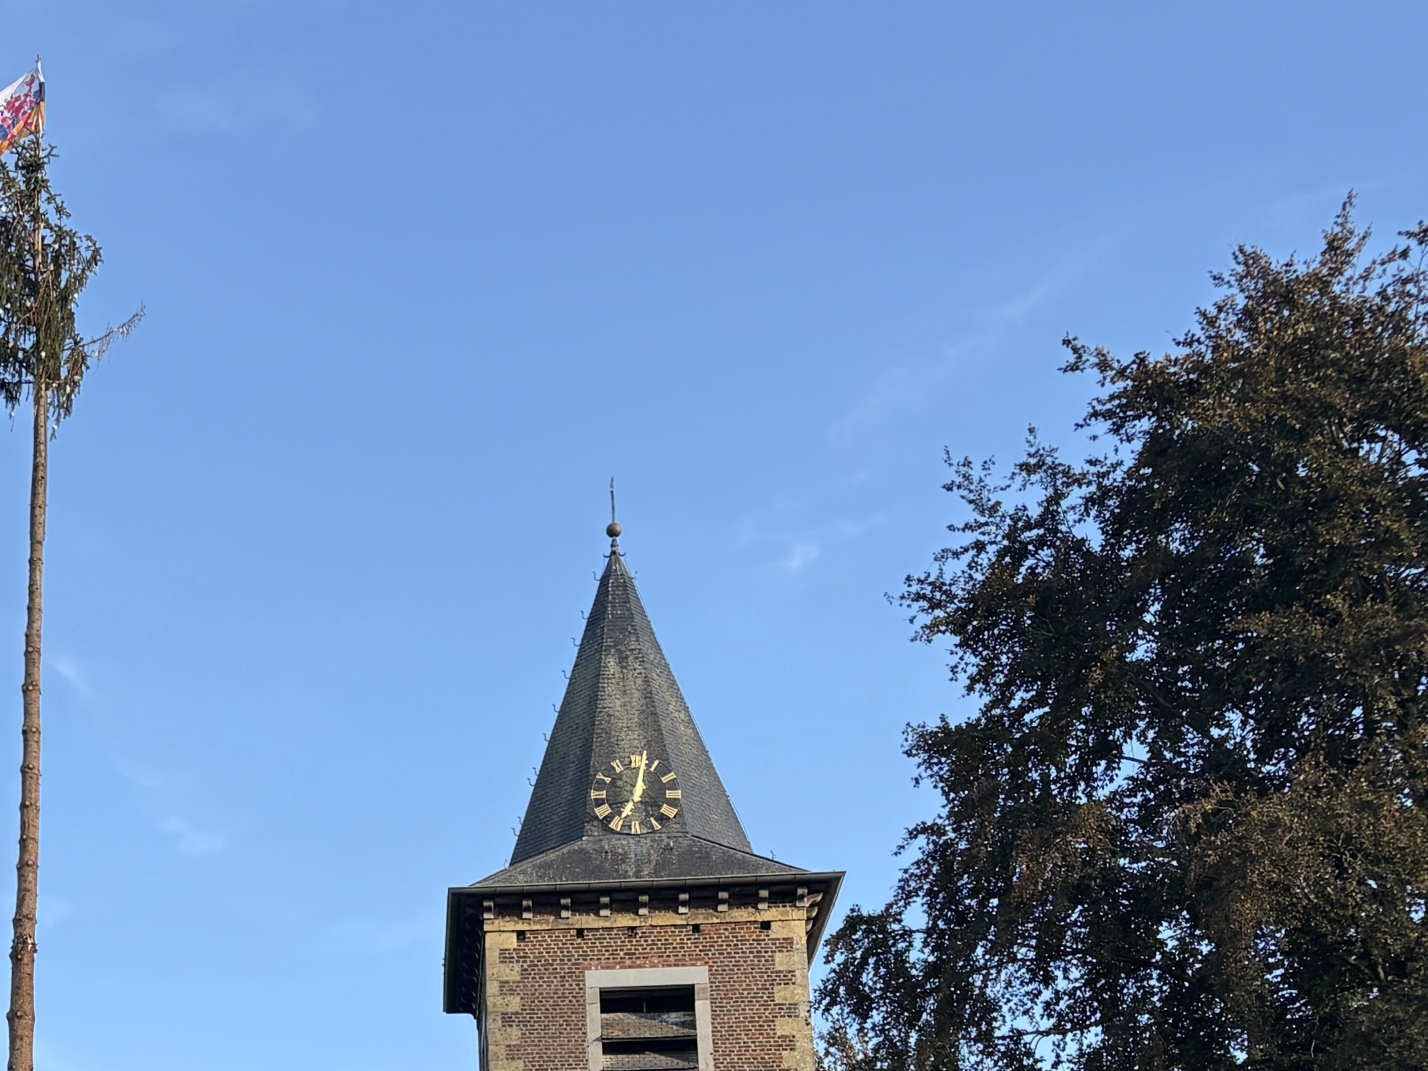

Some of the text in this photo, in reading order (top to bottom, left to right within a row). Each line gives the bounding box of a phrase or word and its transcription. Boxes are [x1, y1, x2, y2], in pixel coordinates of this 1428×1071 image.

[611, 760, 624, 773] XI
[650, 760, 660, 772] I
[596, 772, 612, 784] X
[661, 771, 677, 783] II
[591, 789, 606, 799] IX
[666, 789, 682, 799] III
[631, 820, 641, 834] VI
[650, 817, 662, 831] V
